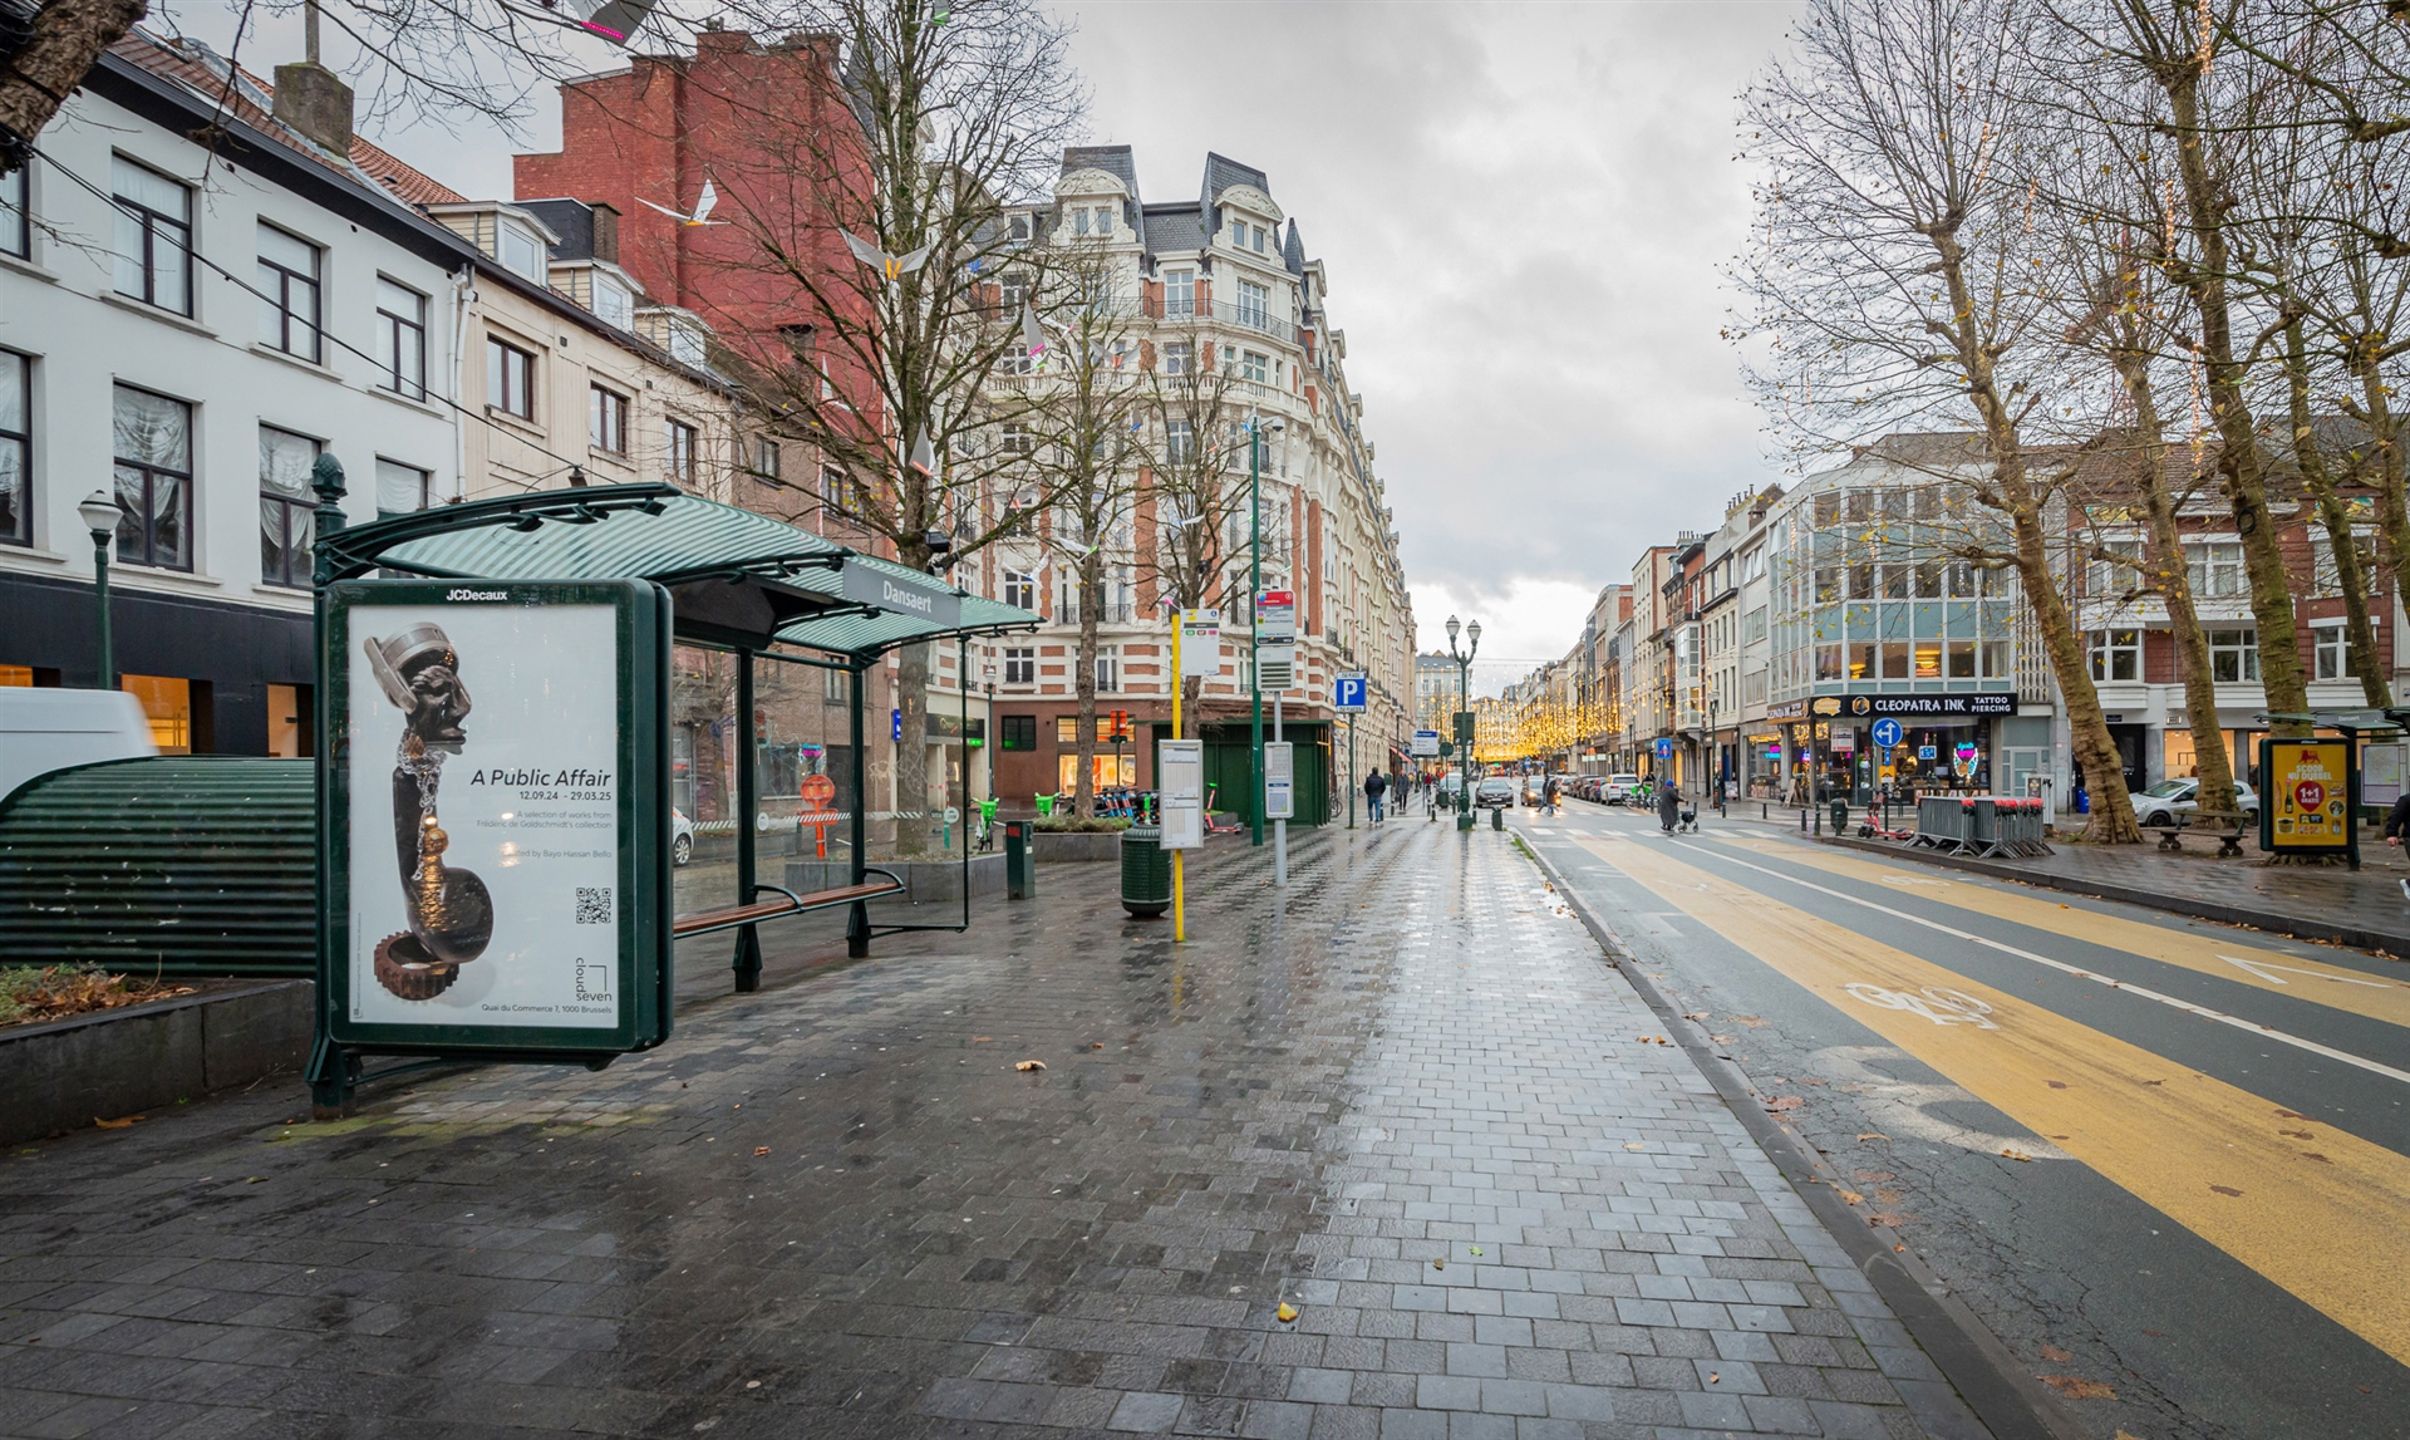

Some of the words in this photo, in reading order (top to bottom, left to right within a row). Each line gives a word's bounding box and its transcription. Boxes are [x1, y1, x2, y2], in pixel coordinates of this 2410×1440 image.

[446, 589, 508, 601] JCDecaux
[883, 580, 932, 613] Dansaert
[1343, 680, 1358, 705] P
[1875, 699, 1941, 712] CLEOPATRA
[1944, 699, 1966, 712] INK
[1971, 705, 2011, 713] PIERCING
[470, 769, 486, 786] A
[490, 769, 551, 786] Public
[555, 769, 611, 787] Affair
[520, 791, 559, 800] 12.09.24
[570, 791, 612, 800] 29.03.25
[2300, 787, 2320, 798] 1+1
[524, 811, 557, 819] selection
[568, 811, 591, 819] works
[593, 811, 612, 819] from
[575, 820, 612, 829] collection
[532, 850, 541, 858] by
[576, 957, 586, 993] cloud
[576, 992, 612, 1002] seven
[481, 1004, 499, 1012] Quai
[501, 1004, 511, 1012] du
[512, 1004, 553, 1013] Commerce
[562, 1005, 579, 1013] 1000
[581, 1006, 612, 1014] Brussels
